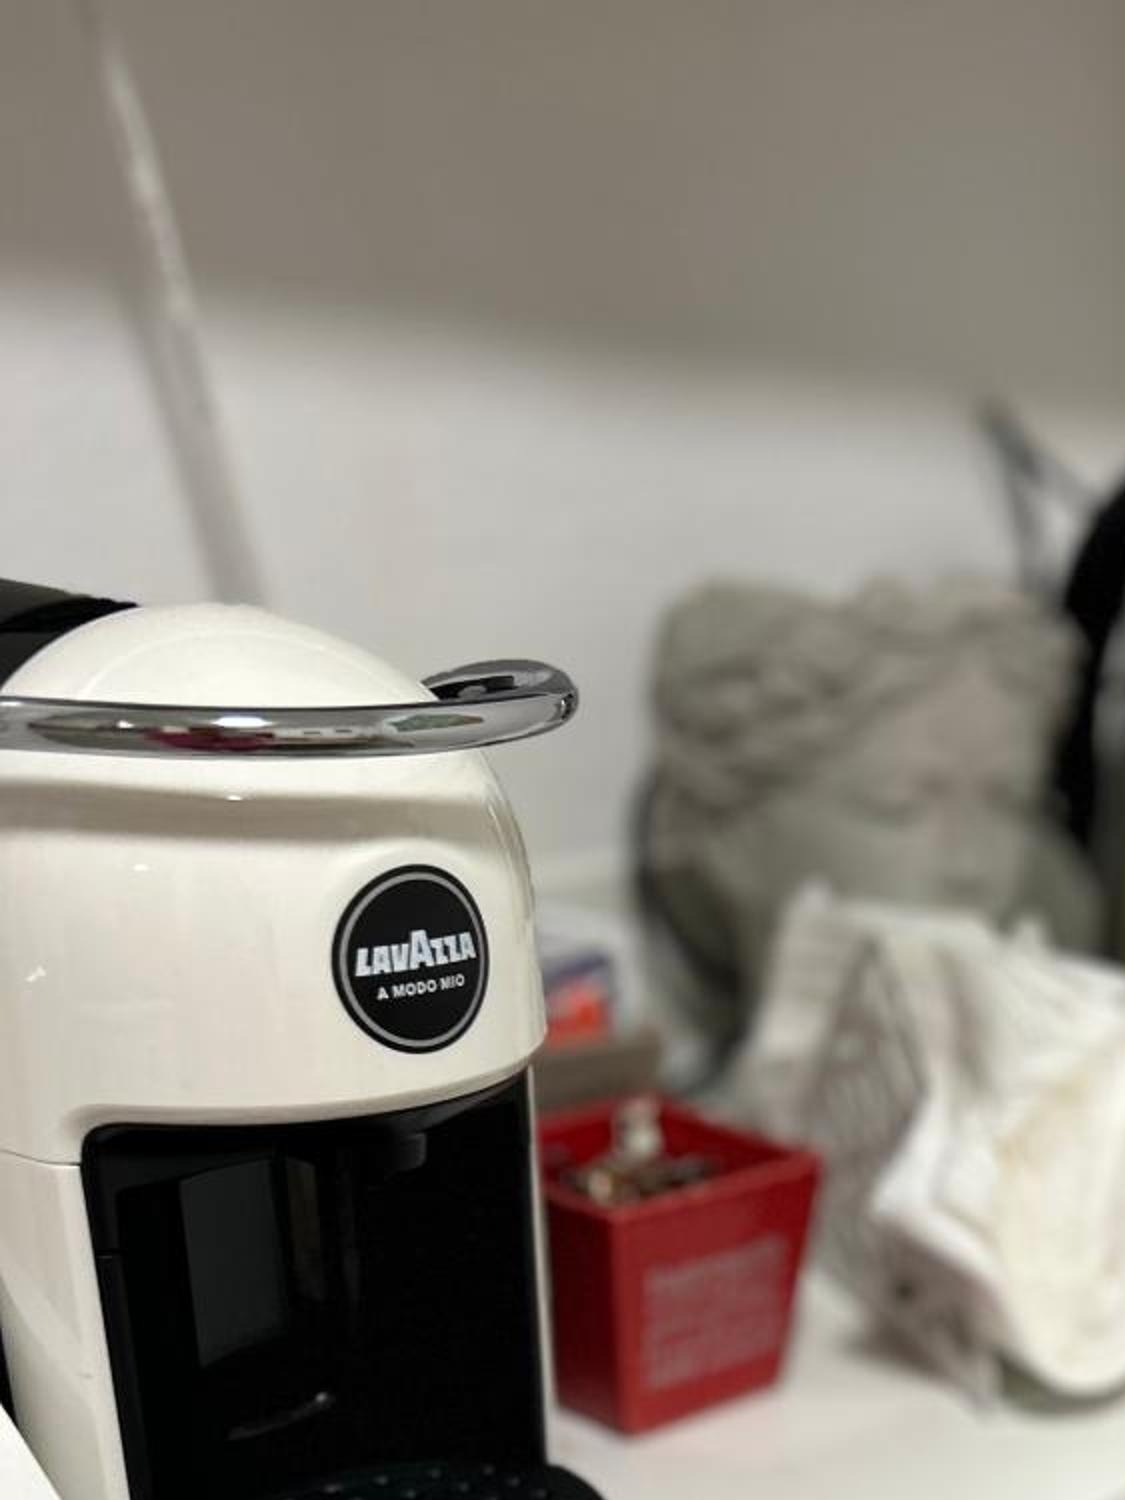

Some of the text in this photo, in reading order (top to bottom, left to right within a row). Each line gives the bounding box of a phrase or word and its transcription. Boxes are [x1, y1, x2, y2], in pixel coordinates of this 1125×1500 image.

[355, 929, 476, 977] LAVAZZA
[377, 974, 465, 1001] A MODO MIO
